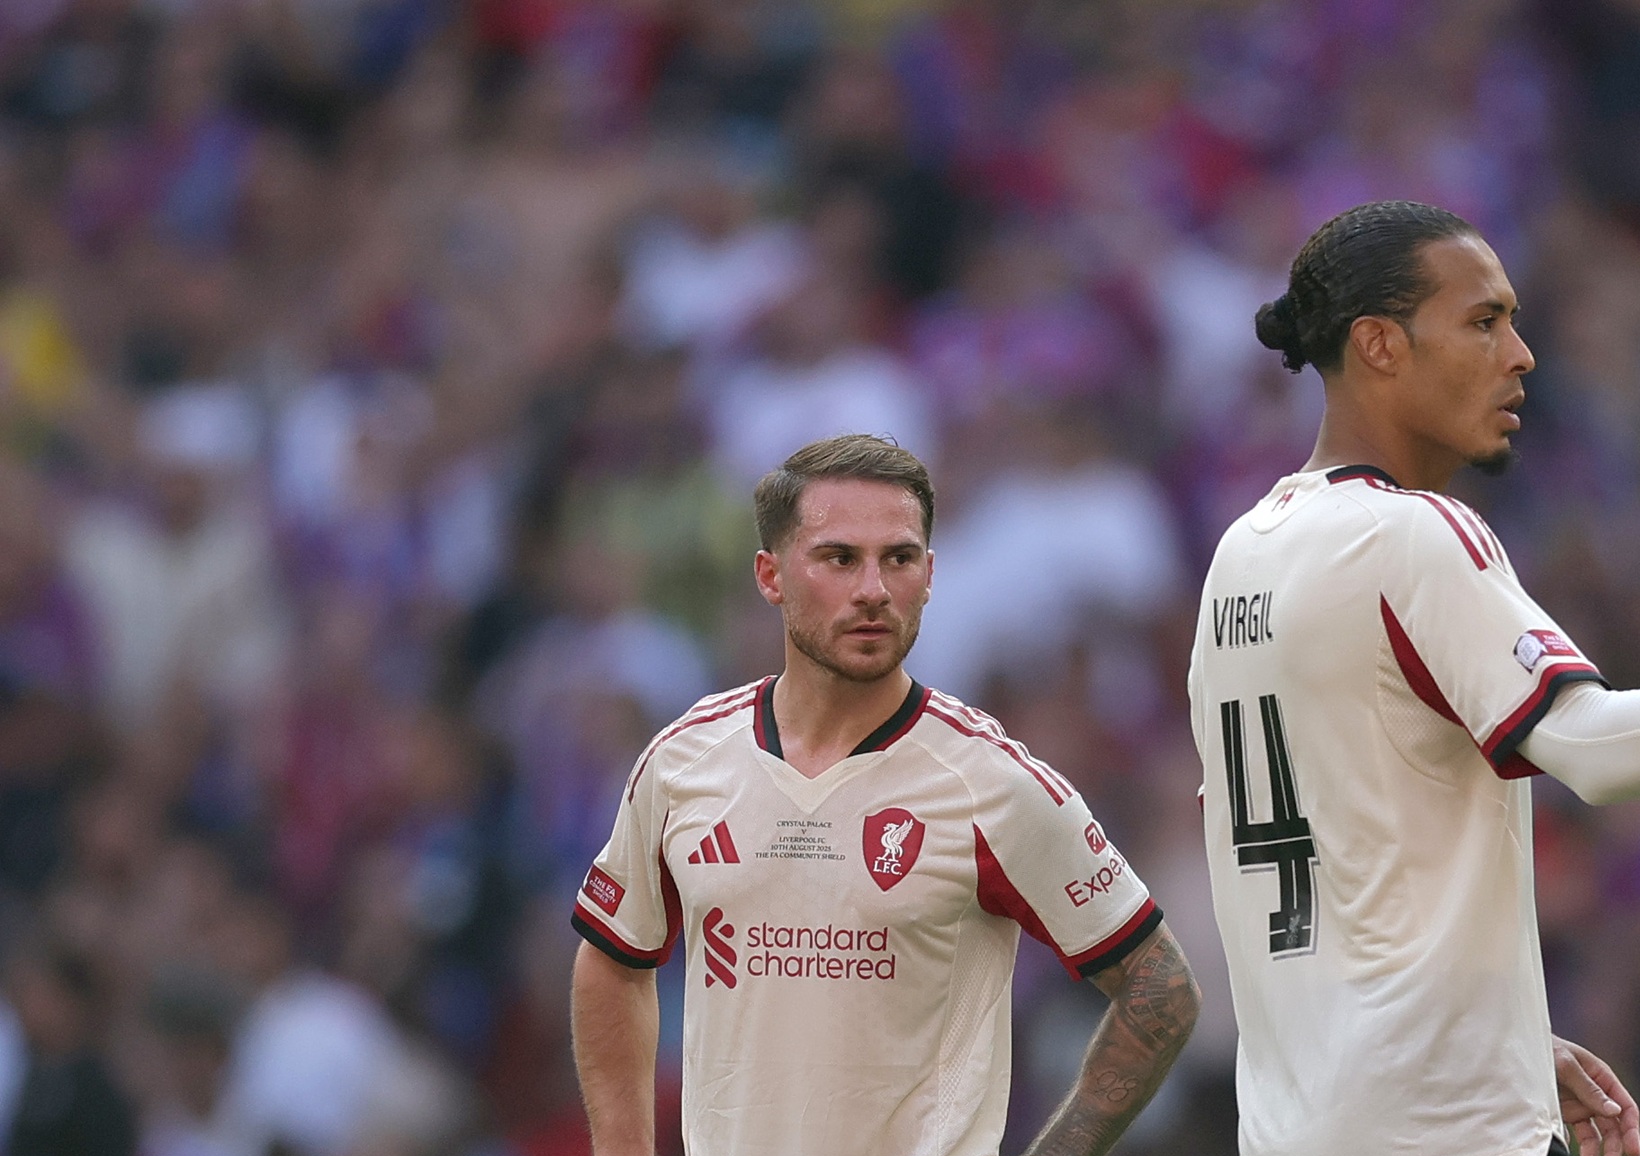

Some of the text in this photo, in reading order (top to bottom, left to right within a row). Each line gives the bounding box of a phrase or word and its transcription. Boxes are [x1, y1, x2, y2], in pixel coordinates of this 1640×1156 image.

[1213, 590, 1273, 649] VIRGIL
[776, 820, 806, 828] CRYSTAL
[1220, 694, 1319, 957] 4
[778, 836, 818, 844] LIVERPOOL
[788, 844, 816, 852] AUGUST
[779, 852, 821, 860] COMMUNITY
[821, 853, 846, 861] SHIELD
[605, 884, 616, 897] FA
[747, 921, 888, 951] standard
[747, 950, 896, 980] chartered
